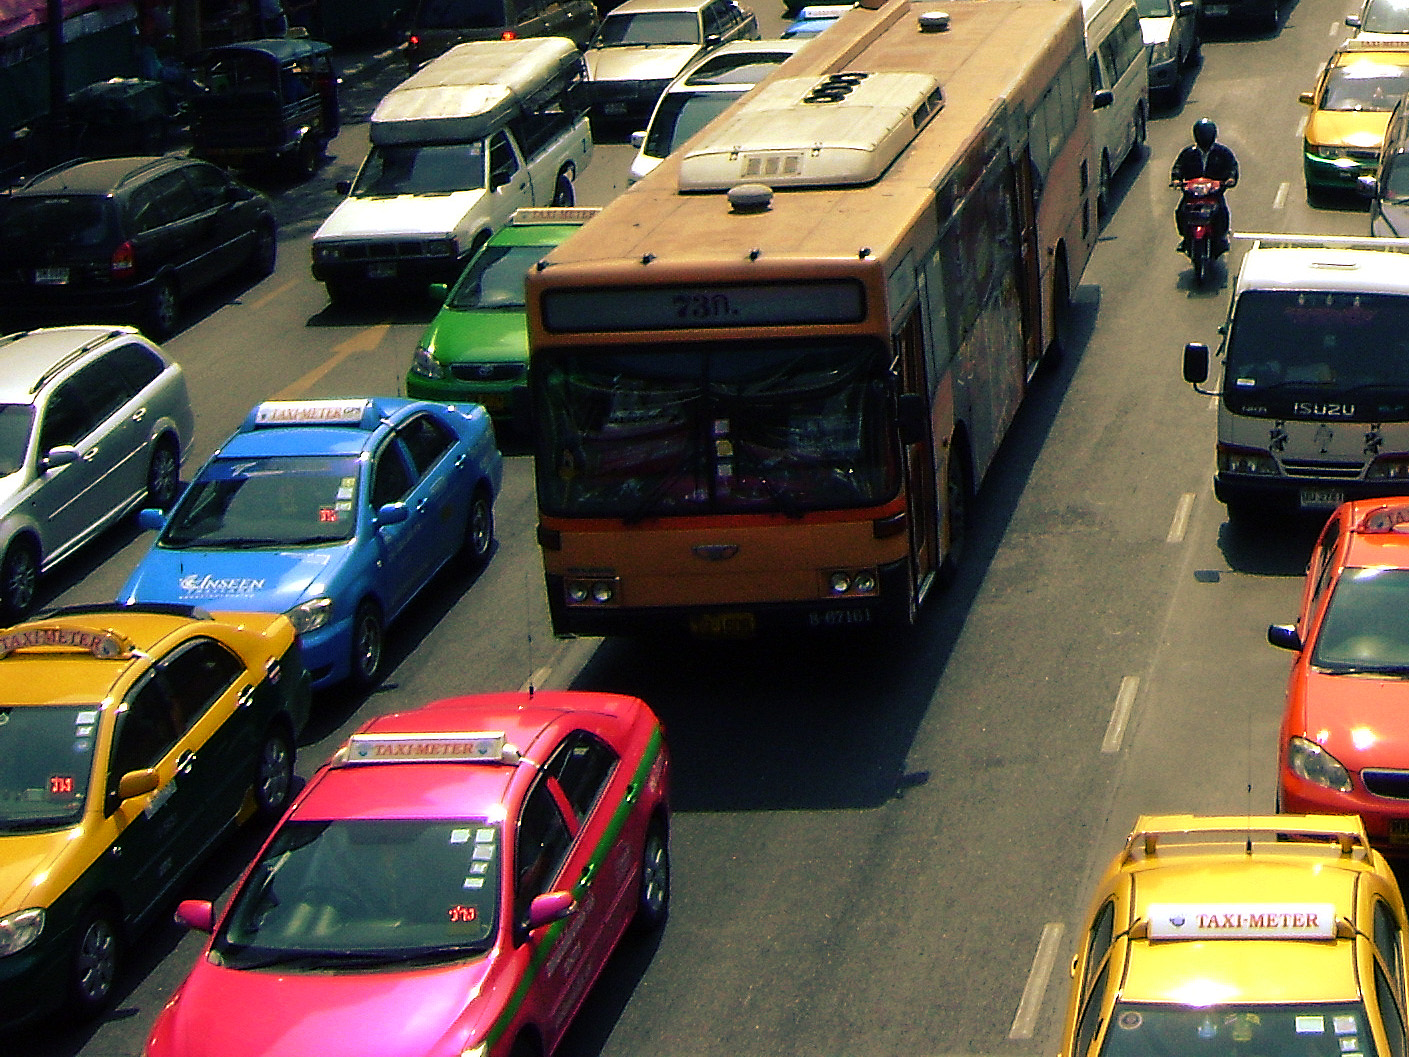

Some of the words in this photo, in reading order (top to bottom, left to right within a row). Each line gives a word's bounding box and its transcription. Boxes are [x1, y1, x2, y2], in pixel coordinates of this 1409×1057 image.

[1294, 402, 1355, 417] ISUZU
[375, 743, 475, 757] TAXI-METER
[1195, 911, 1320, 930] TAXI-METER
